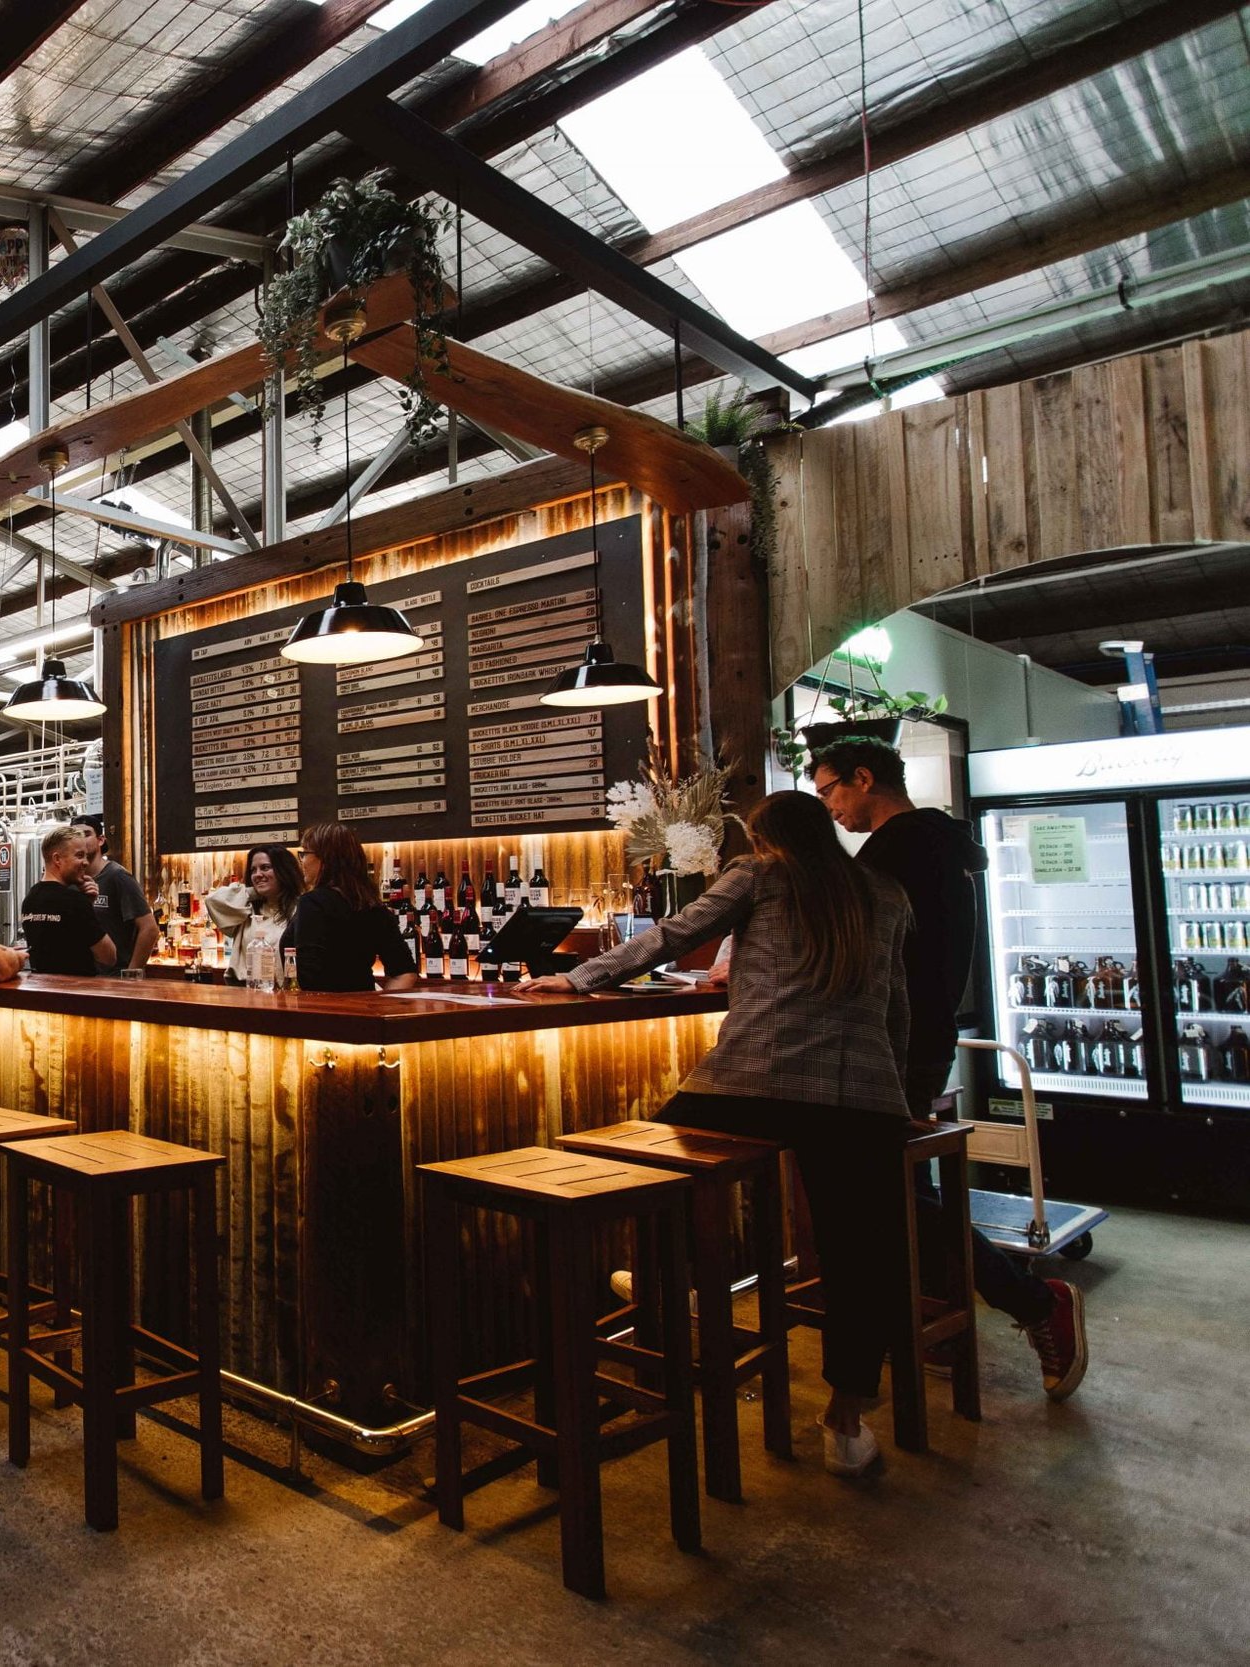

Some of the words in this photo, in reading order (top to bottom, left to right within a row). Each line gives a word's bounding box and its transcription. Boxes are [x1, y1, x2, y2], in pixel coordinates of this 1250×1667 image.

[471, 577, 499, 590] COCKTAILS
[472, 613, 492, 622] BARREL
[509, 603, 538, 615] ESPRESSO
[541, 597, 566, 608] MARTINI
[471, 628, 495, 638] NEGRONI
[472, 642, 503, 653] MARGARITA
[486, 657, 517, 668] FASHIONED
[218, 670, 231, 679] LAGER
[474, 677, 505, 686] BUCKETTYS
[508, 670, 536, 680] IRONBARK
[539, 666, 566, 676] WHISKEY
[210, 685, 225, 693] BITTER
[195, 702, 210, 710] AUSSIE
[471, 701, 510, 712] MERCHANDISE
[473, 728, 500, 737] BUCKETTYS
[521, 721, 538, 731] HOODIE
[588, 729, 596, 738] 47
[473, 757, 495, 766] STUBBIE
[499, 754, 521, 762] HOLDER
[474, 771, 498, 779] TRUCKER
[475, 815, 506, 823] BUCKETTYS
